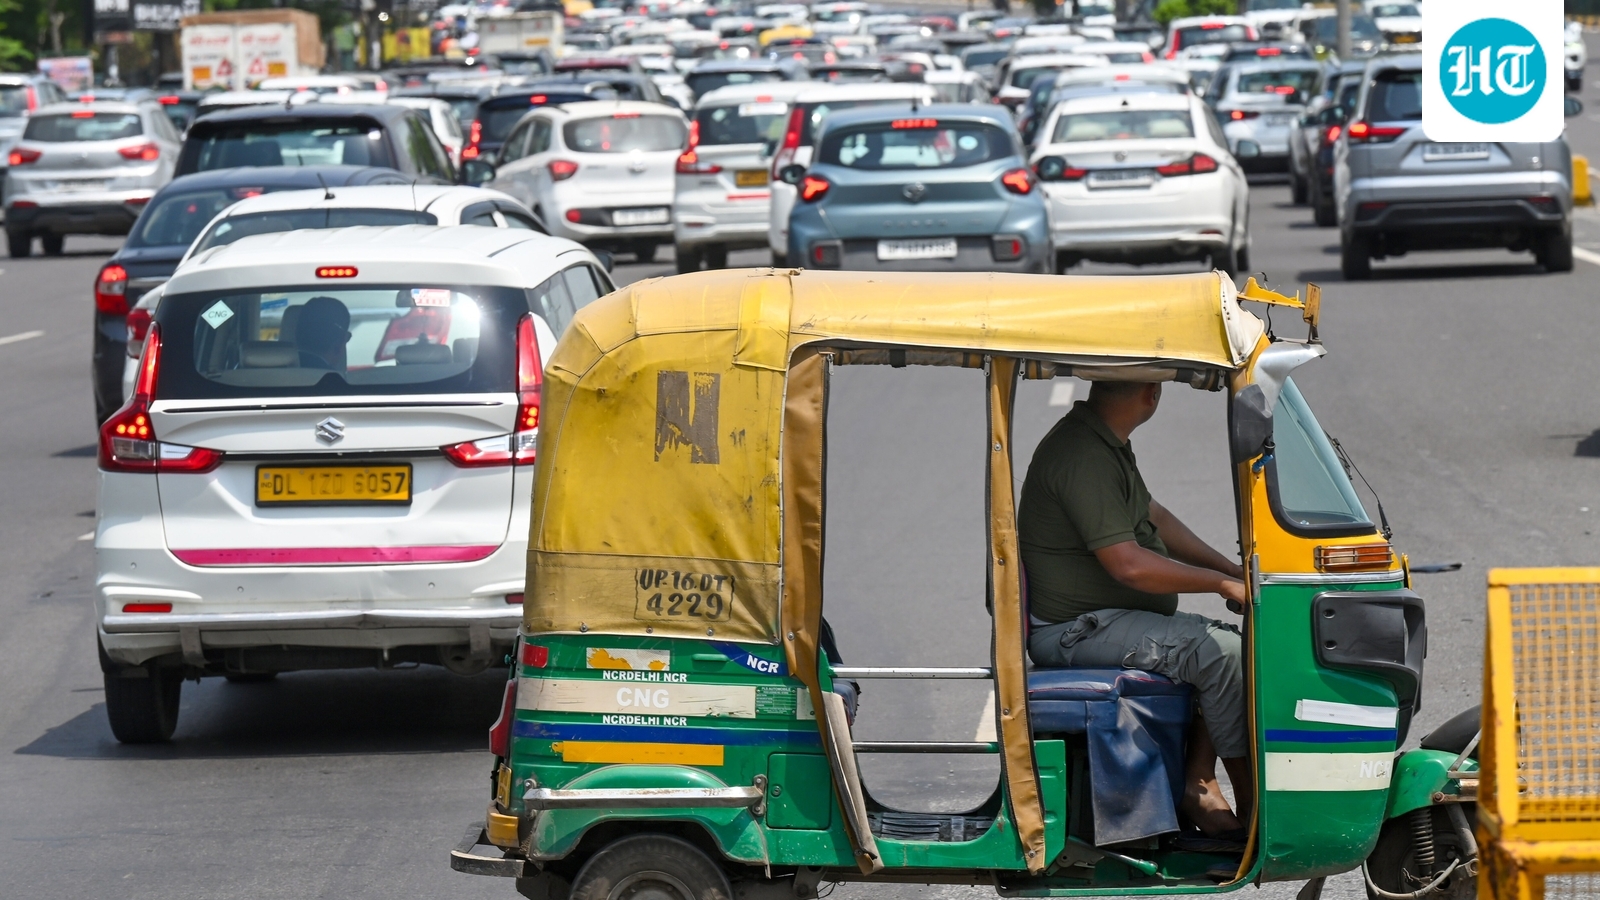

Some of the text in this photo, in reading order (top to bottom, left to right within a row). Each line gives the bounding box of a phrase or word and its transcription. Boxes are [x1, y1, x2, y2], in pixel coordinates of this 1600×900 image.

[208, 310, 228, 319] CNG
[273, 474, 297, 495] DL
[353, 472, 406, 494] 6057
[646, 592, 723, 620] 4229
[747, 654, 779, 674] NCR
[602, 670, 687, 683] NCRDELHI NCR
[616, 687, 669, 709] CNG
[602, 714, 687, 727] NCRDELHI NCR
